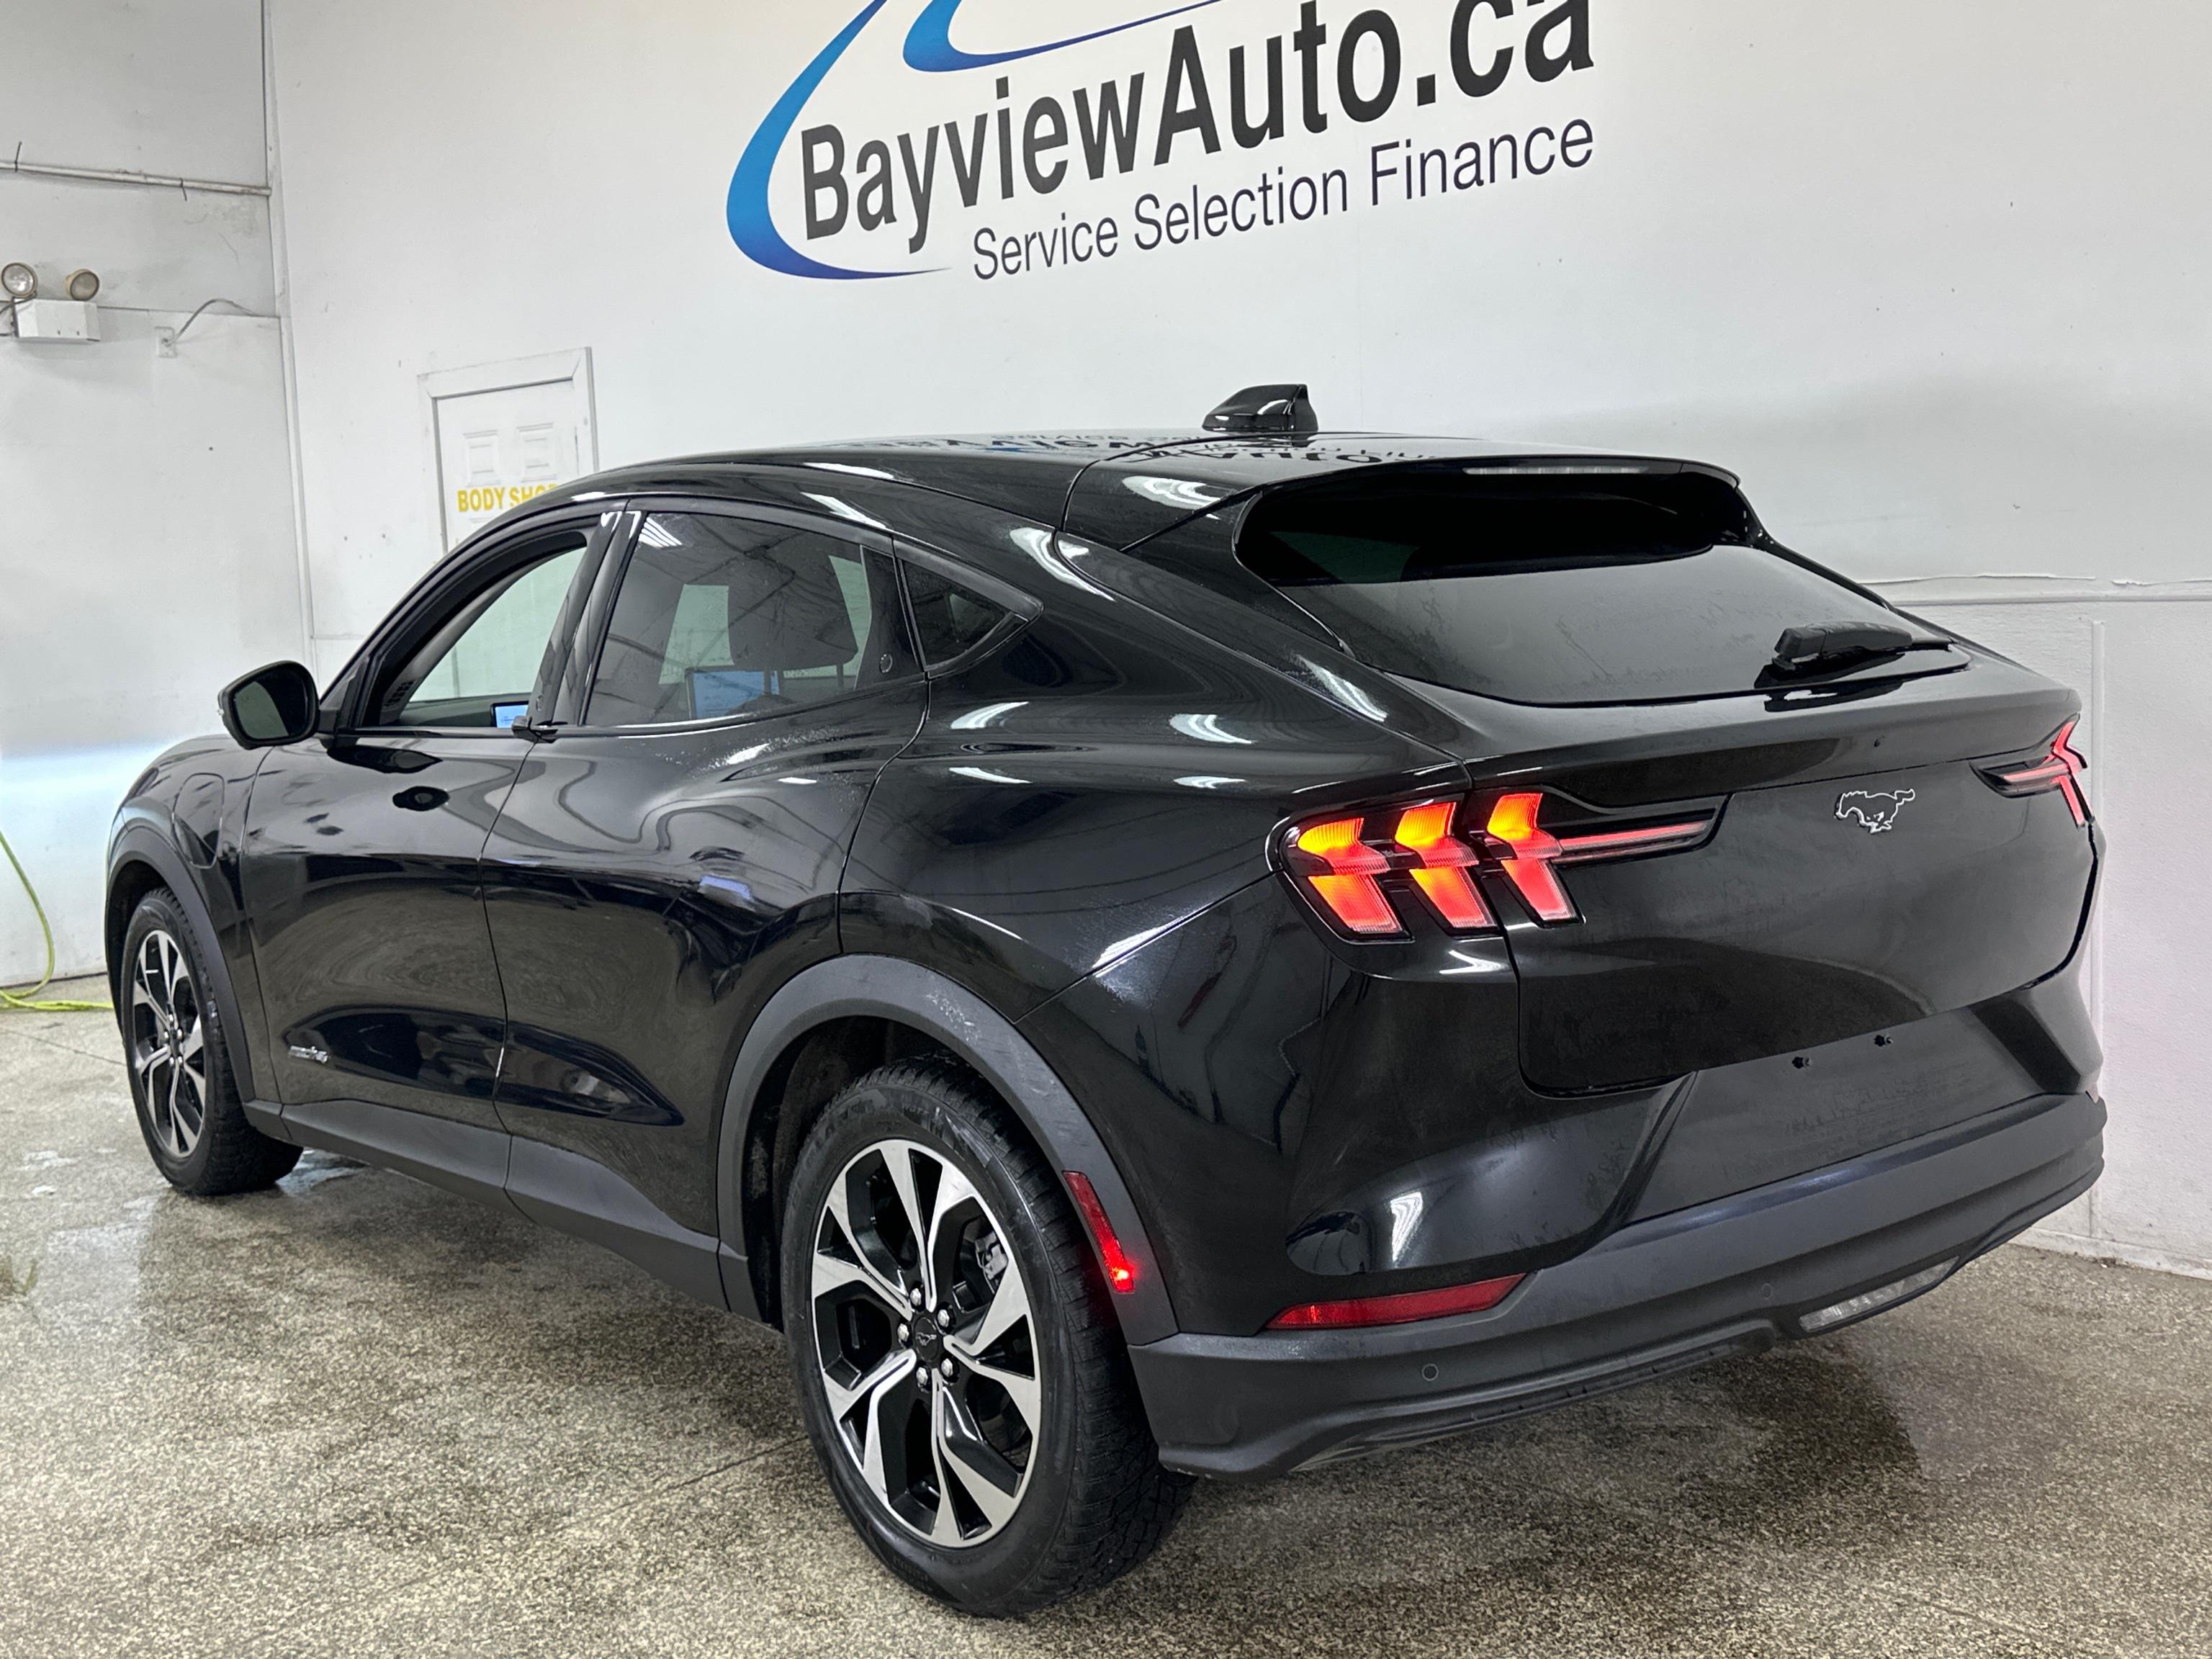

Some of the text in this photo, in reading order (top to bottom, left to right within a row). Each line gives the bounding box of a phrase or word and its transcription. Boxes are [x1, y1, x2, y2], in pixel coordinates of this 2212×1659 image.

[802, 0, 1594, 254] BayviewAuto.ca
[974, 119, 1593, 280] Service Selection Finance
[457, 483, 559, 512] BODY SH
